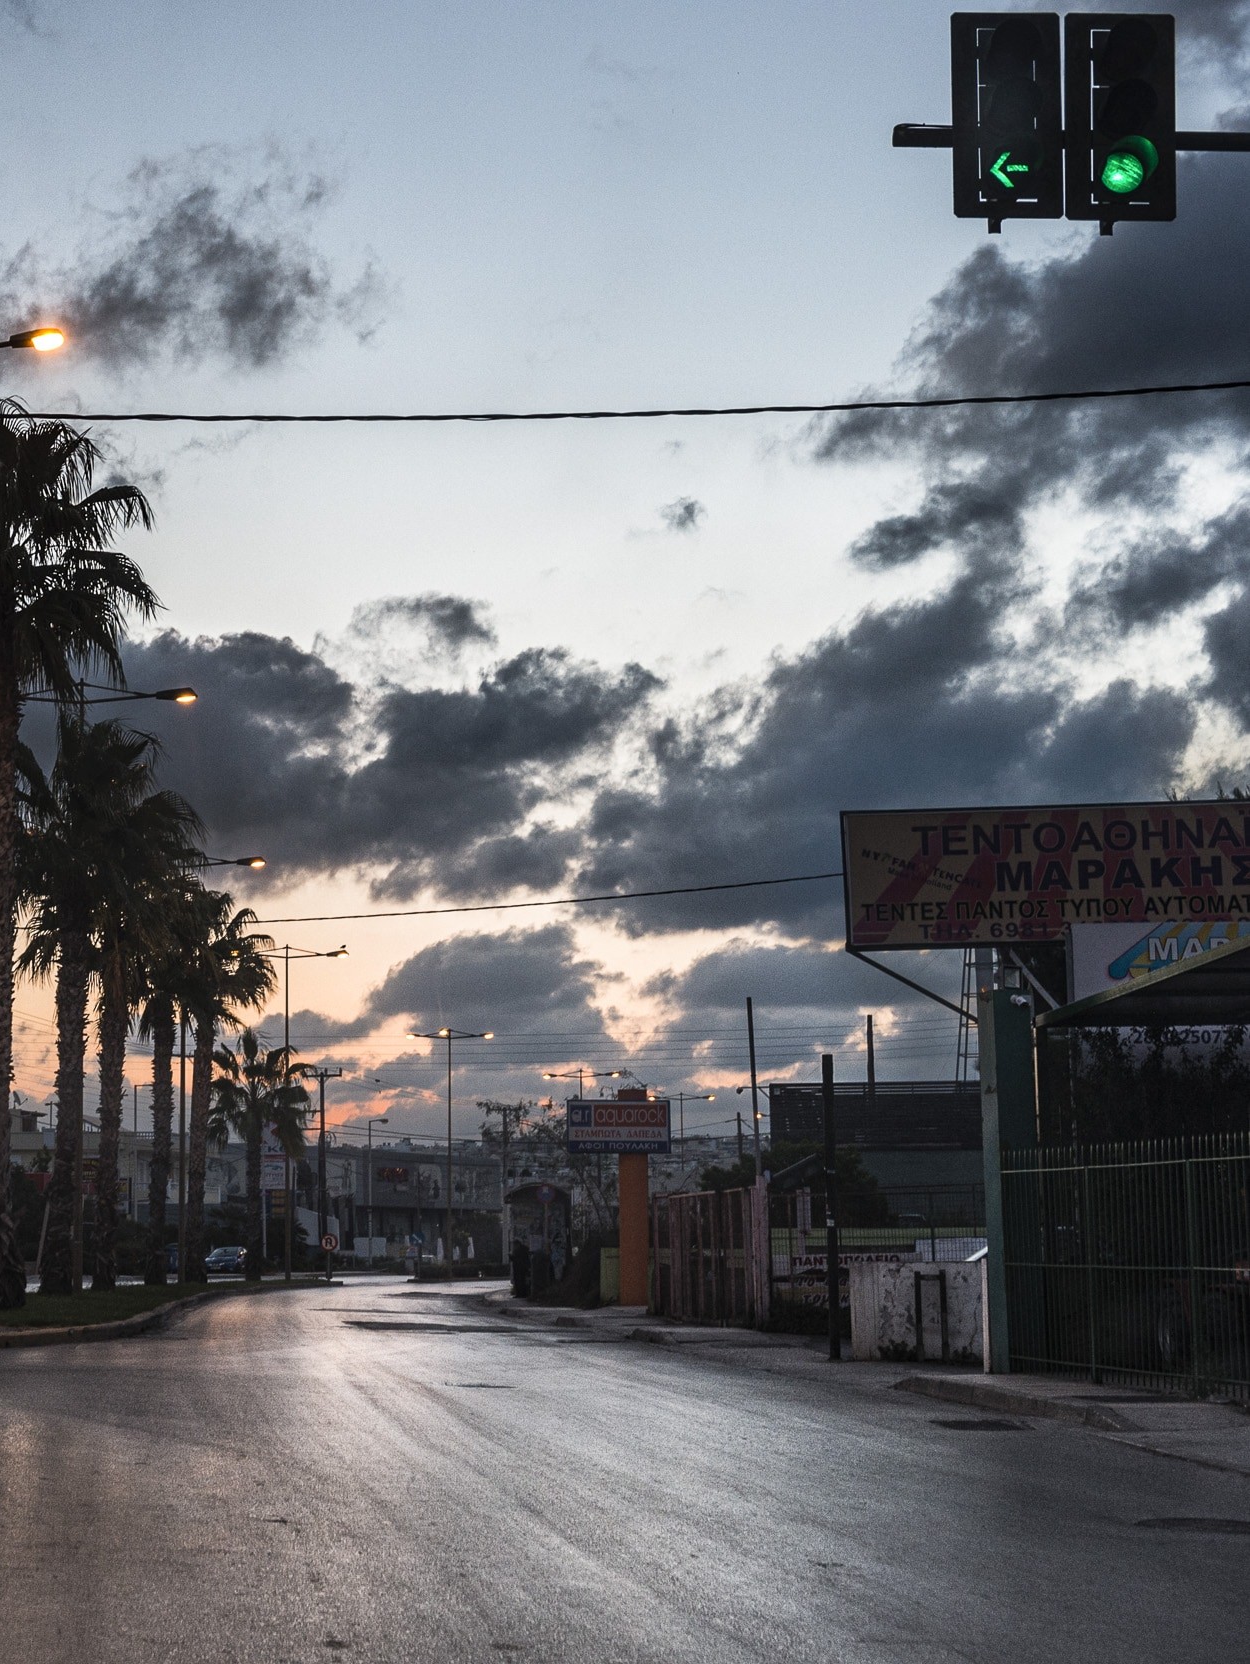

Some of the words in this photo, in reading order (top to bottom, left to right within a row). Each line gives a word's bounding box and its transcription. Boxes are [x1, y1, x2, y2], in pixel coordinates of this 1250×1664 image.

[996, 855, 1250, 892] ΜΑΡΑΚΗΣ
[920, 876, 952, 891] olland
[861, 901, 948, 922] ΤΕΝΤΕΣ
[955, 899, 1050, 920] ΠΑΝΤΟΣ
[1056, 897, 1134, 917] ΤΥΠΟΥ
[990, 921, 1050, 939] 6981
[595, 1106, 665, 1126] aquarock
[574, 1130, 622, 1139] ΣΤΑΜΠΩΤΑ
[626, 1129, 662, 1139] ΔΑΠΕΔΑ
[609, 1142, 658, 1150] ΠΟΥΛΑΚΗ
